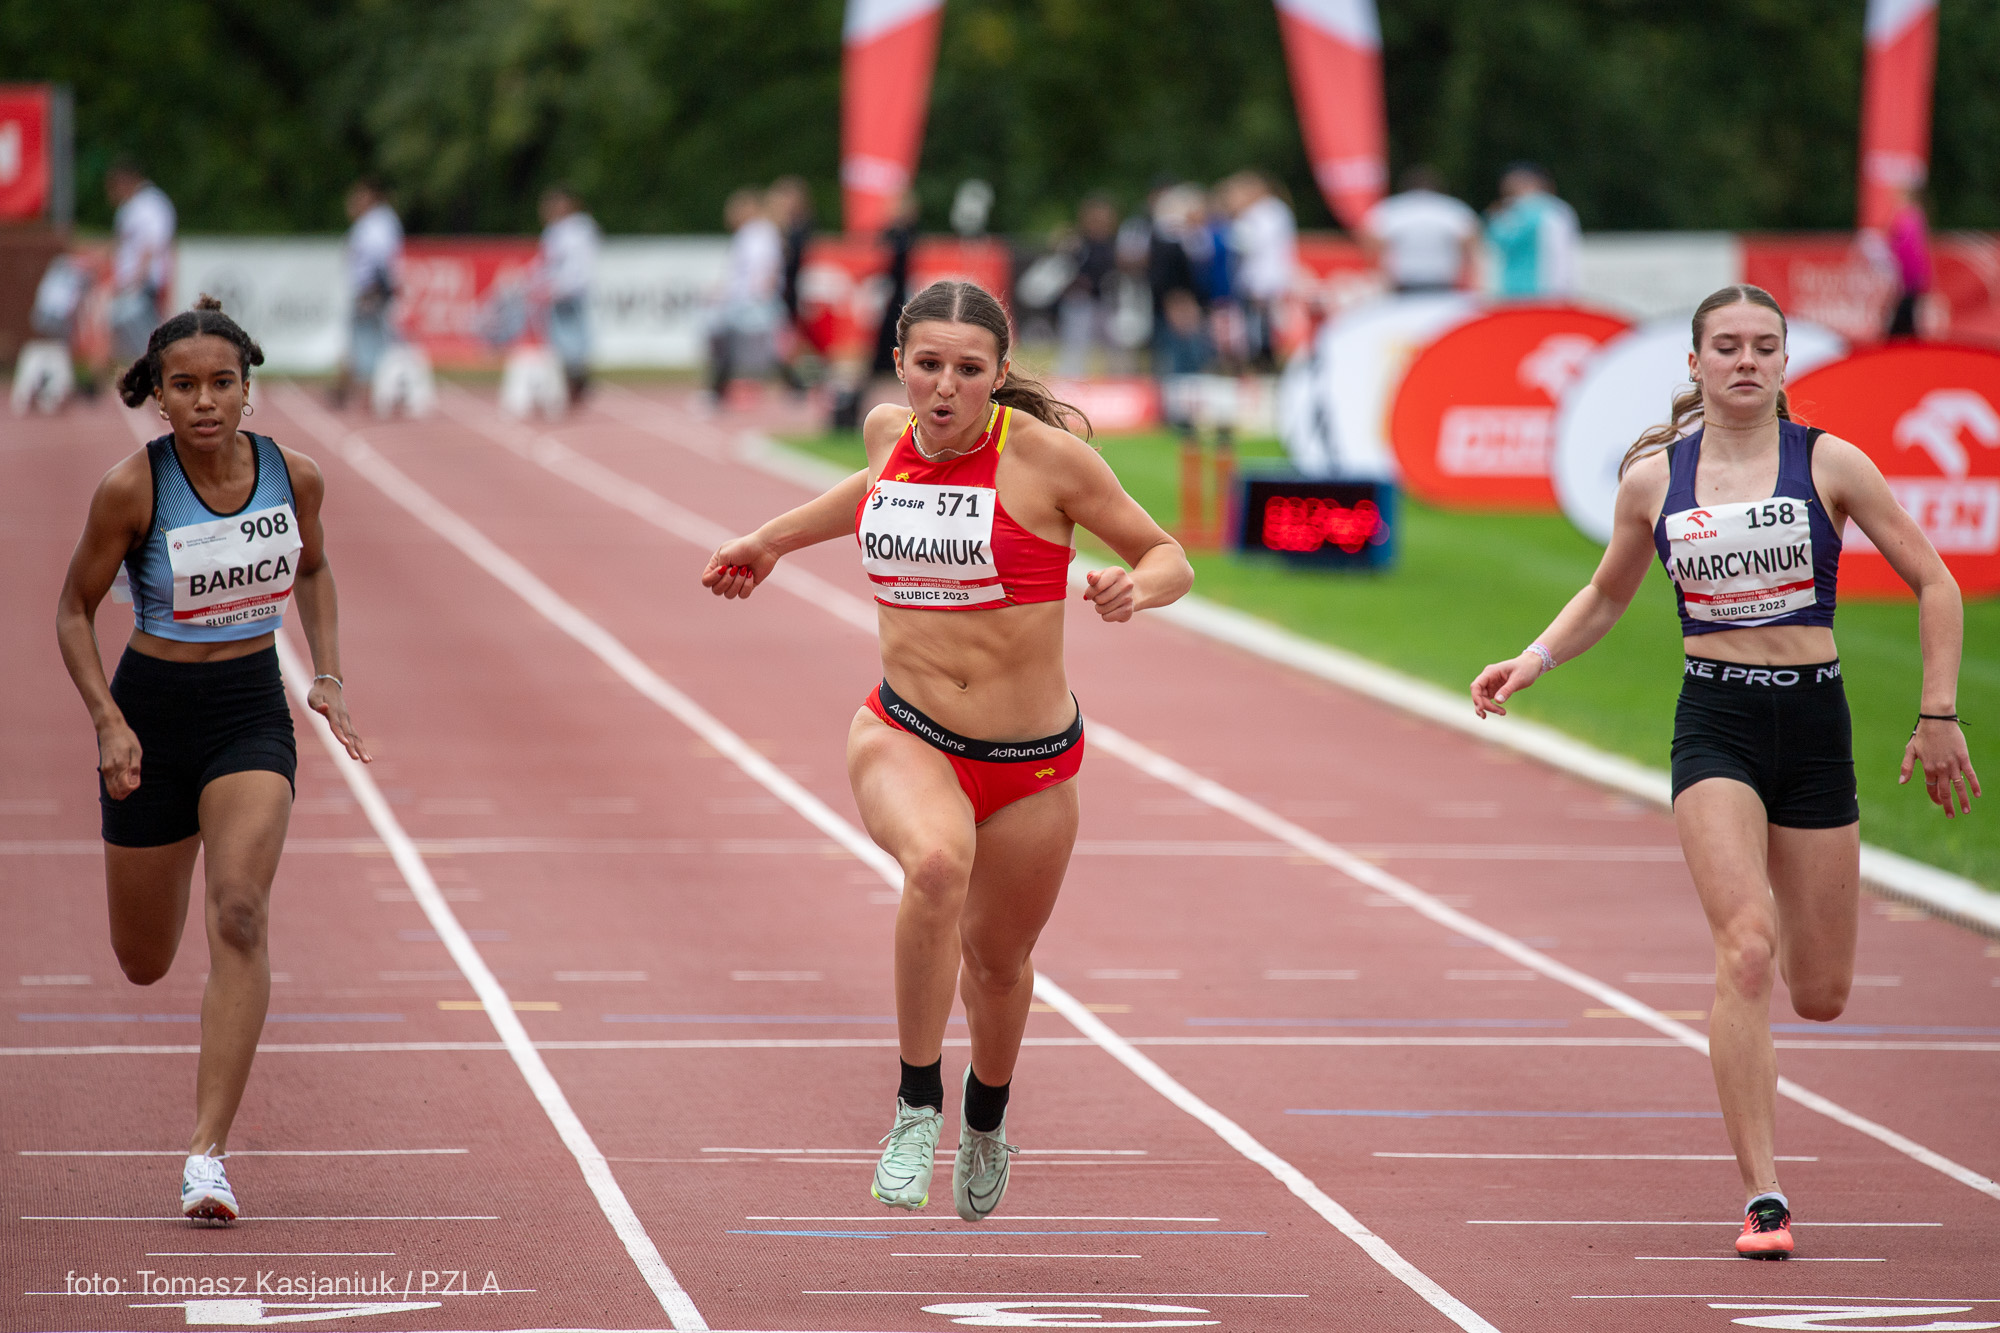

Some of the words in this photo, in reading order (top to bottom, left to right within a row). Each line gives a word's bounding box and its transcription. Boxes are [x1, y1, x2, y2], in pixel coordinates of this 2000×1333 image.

[936, 492, 980, 518] 571
[1745, 502, 1796, 529] 158
[240, 512, 289, 543] 908
[1683, 530, 1718, 541] ORLEN
[865, 532, 987, 565] ROMANIUK
[1676, 543, 1808, 580] MARCYNIUK
[189, 555, 291, 597] BARICA
[894, 591, 940, 600] SŁUBICE
[942, 591, 970, 600] 2023
[1710, 604, 1757, 617] SŁUBICE
[1759, 599, 1786, 612] 2023
[205, 612, 249, 627] SŁUBICE
[251, 605, 277, 617] 2023
[1684, 658, 1717, 679] KE
[1721, 666, 1800, 687] PRO
